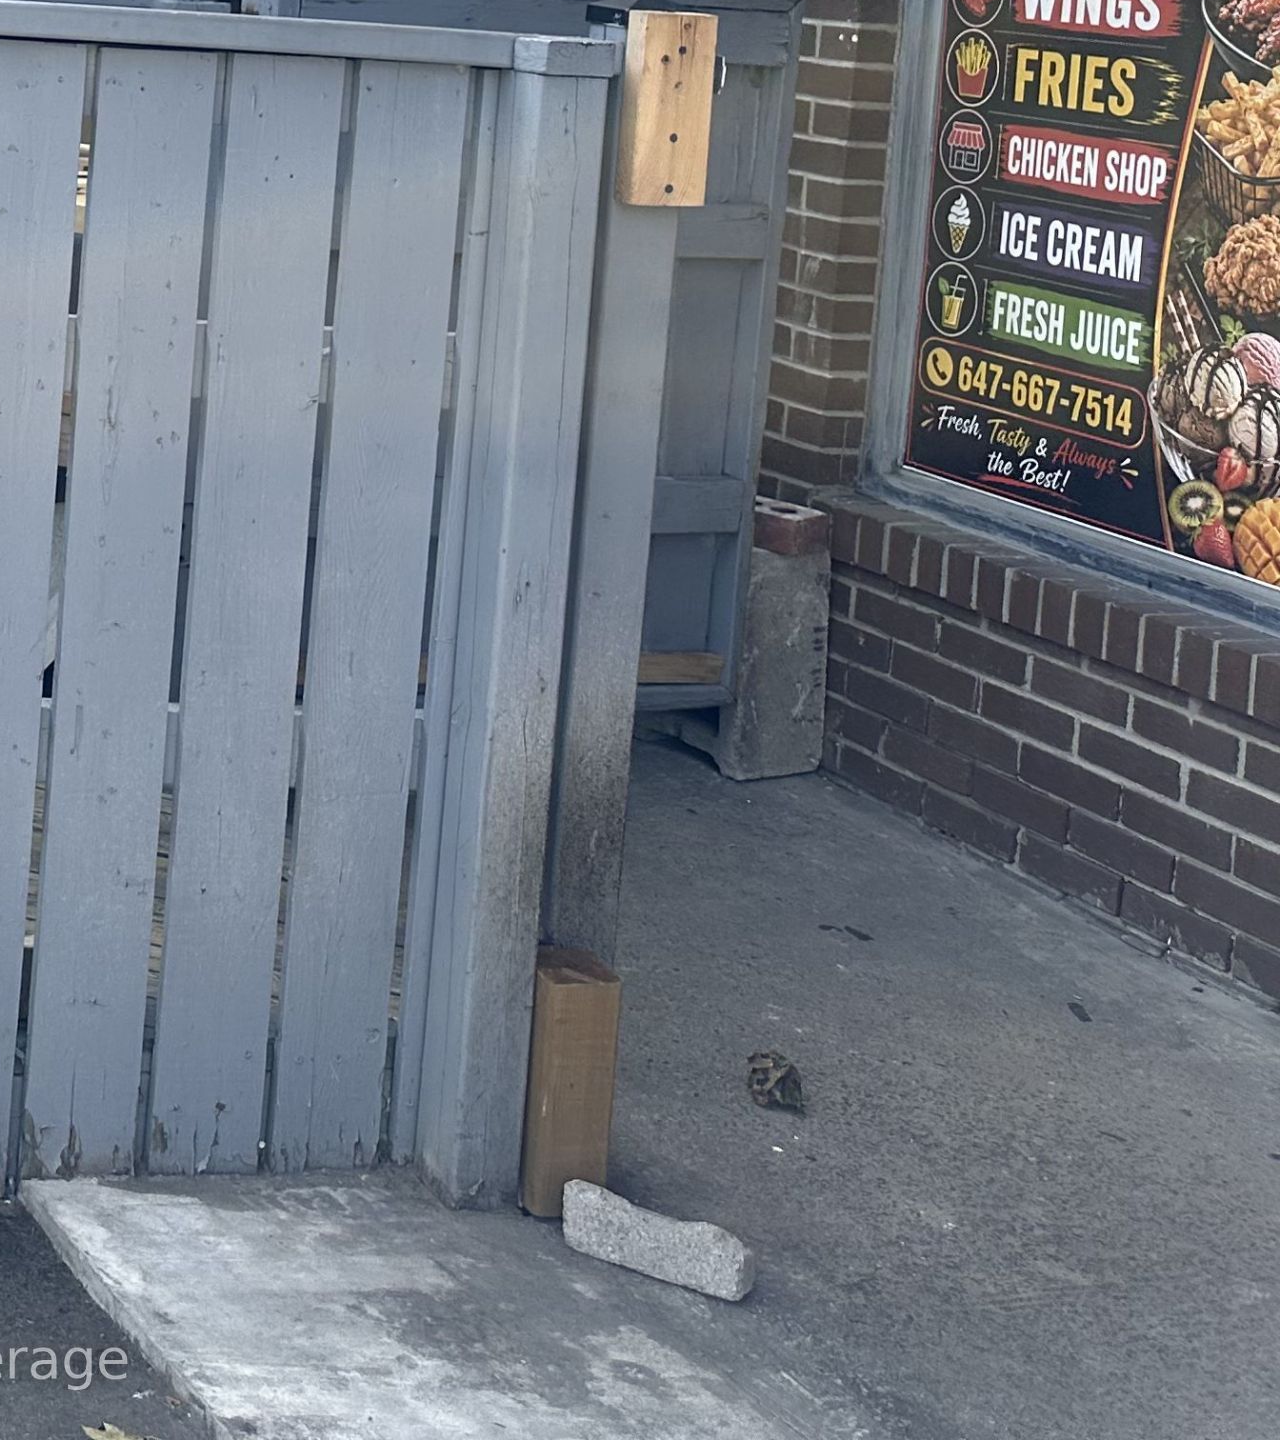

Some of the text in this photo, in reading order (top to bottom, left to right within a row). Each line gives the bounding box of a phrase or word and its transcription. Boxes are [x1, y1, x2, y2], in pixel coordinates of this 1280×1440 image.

[1013, 47, 1137, 118] FRIES
[1007, 135, 1167, 198] CHICKEN SHOP
[999, 211, 1143, 282] ICE CREAM
[992, 290, 1142, 365] FRESH JUICE
[958, 355, 1133, 437] 647-667-7514
[937, 405, 1117, 480] Fresh, Tasty & Always
[987, 451, 1071, 494] the Best!
